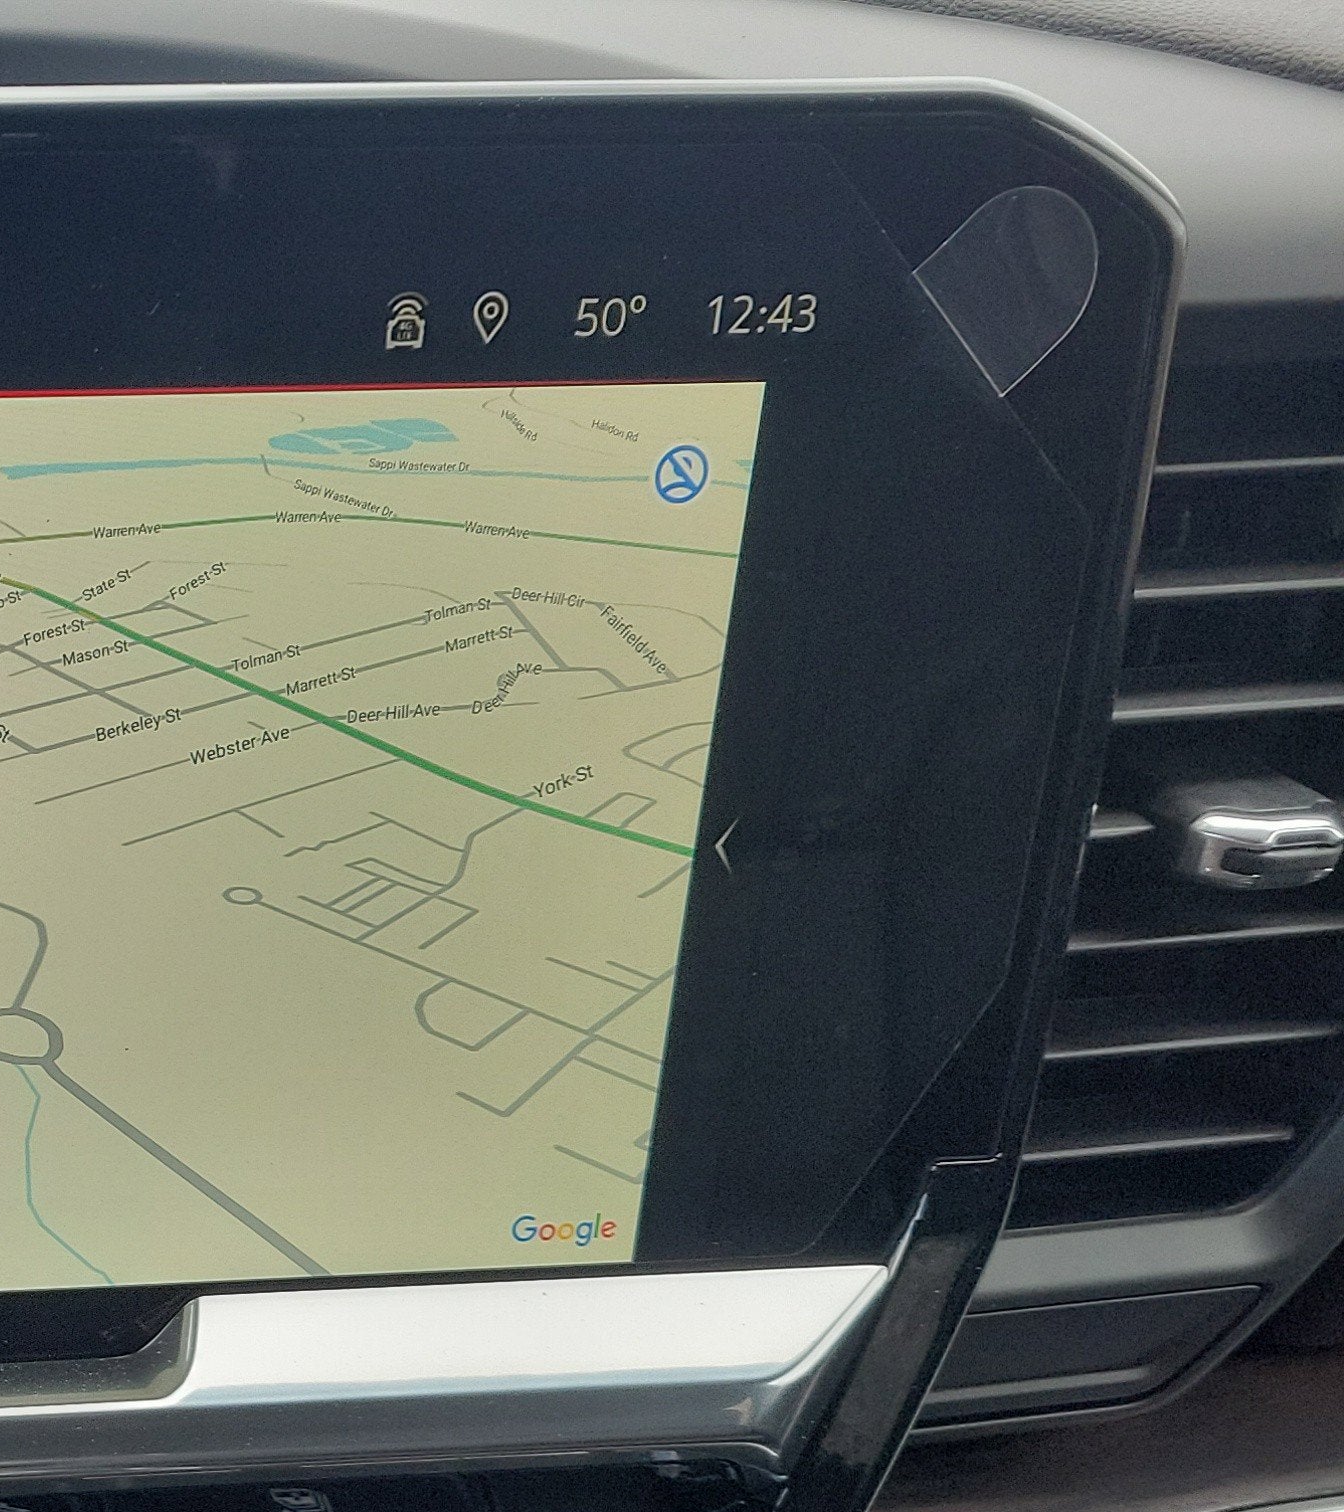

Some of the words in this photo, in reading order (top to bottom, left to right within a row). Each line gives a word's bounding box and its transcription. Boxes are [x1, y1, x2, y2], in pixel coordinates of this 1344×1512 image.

[575, 295, 646, 337] 50°
[708, 293, 817, 335] 12:43
[626, 431, 639, 442] Rd
[369, 458, 396, 470] Sappi
[399, 459, 456, 472] Wastewater
[459, 462, 469, 472] Dr
[293, 479, 321, 495] Sappi
[323, 487, 380, 513] Wastewater
[382, 505, 393, 518] Dr
[94, 525, 136, 539] Warren
[138, 523, 161, 535] Ave
[274, 513, 315, 524] Warren
[320, 511, 342, 522] Ave
[465, 520, 507, 535] Warren
[509, 526, 530, 540] Ave
[82, 578, 115, 600] State
[115, 568, 131, 584] St
[169, 573, 213, 600] Forest
[211, 560, 228, 576] St
[6, 589, 22, 603] St
[512, 587, 540, 600] Deer
[544, 591, 562, 605] Hill
[567, 594, 585, 608] Cir
[425, 601, 473, 623] Tolman
[474, 598, 491, 611] St
[23, 624, 68, 645] Forest
[69, 619, 86, 633] St
[445, 630, 497, 653] Marrett
[497, 626, 513, 639] St
[601, 606, 648, 653] Fairfield
[645, 650, 667, 674] Ave
[62, 646, 111, 666] Mason
[113, 640, 129, 653] St
[232, 650, 283, 671] Tolman
[285, 644, 301, 658] St
[286, 673, 337, 696] Marrett
[340, 667, 356, 681] St
[472, 695, 503, 714] Deer
[499, 671, 518, 693] Hill
[516, 663, 542, 675] Ave
[95, 714, 160, 741] Berkeley
[165, 708, 182, 723] St
[347, 708, 381, 724] Deer
[385, 705, 410, 720] Hill
[413, 704, 440, 717] Ave
[190, 737, 256, 765] Webster
[261, 728, 290, 745] Ave
[533, 774, 572, 798] York
[575, 765, 594, 781] St
[512, 1213, 617, 1246] Google
